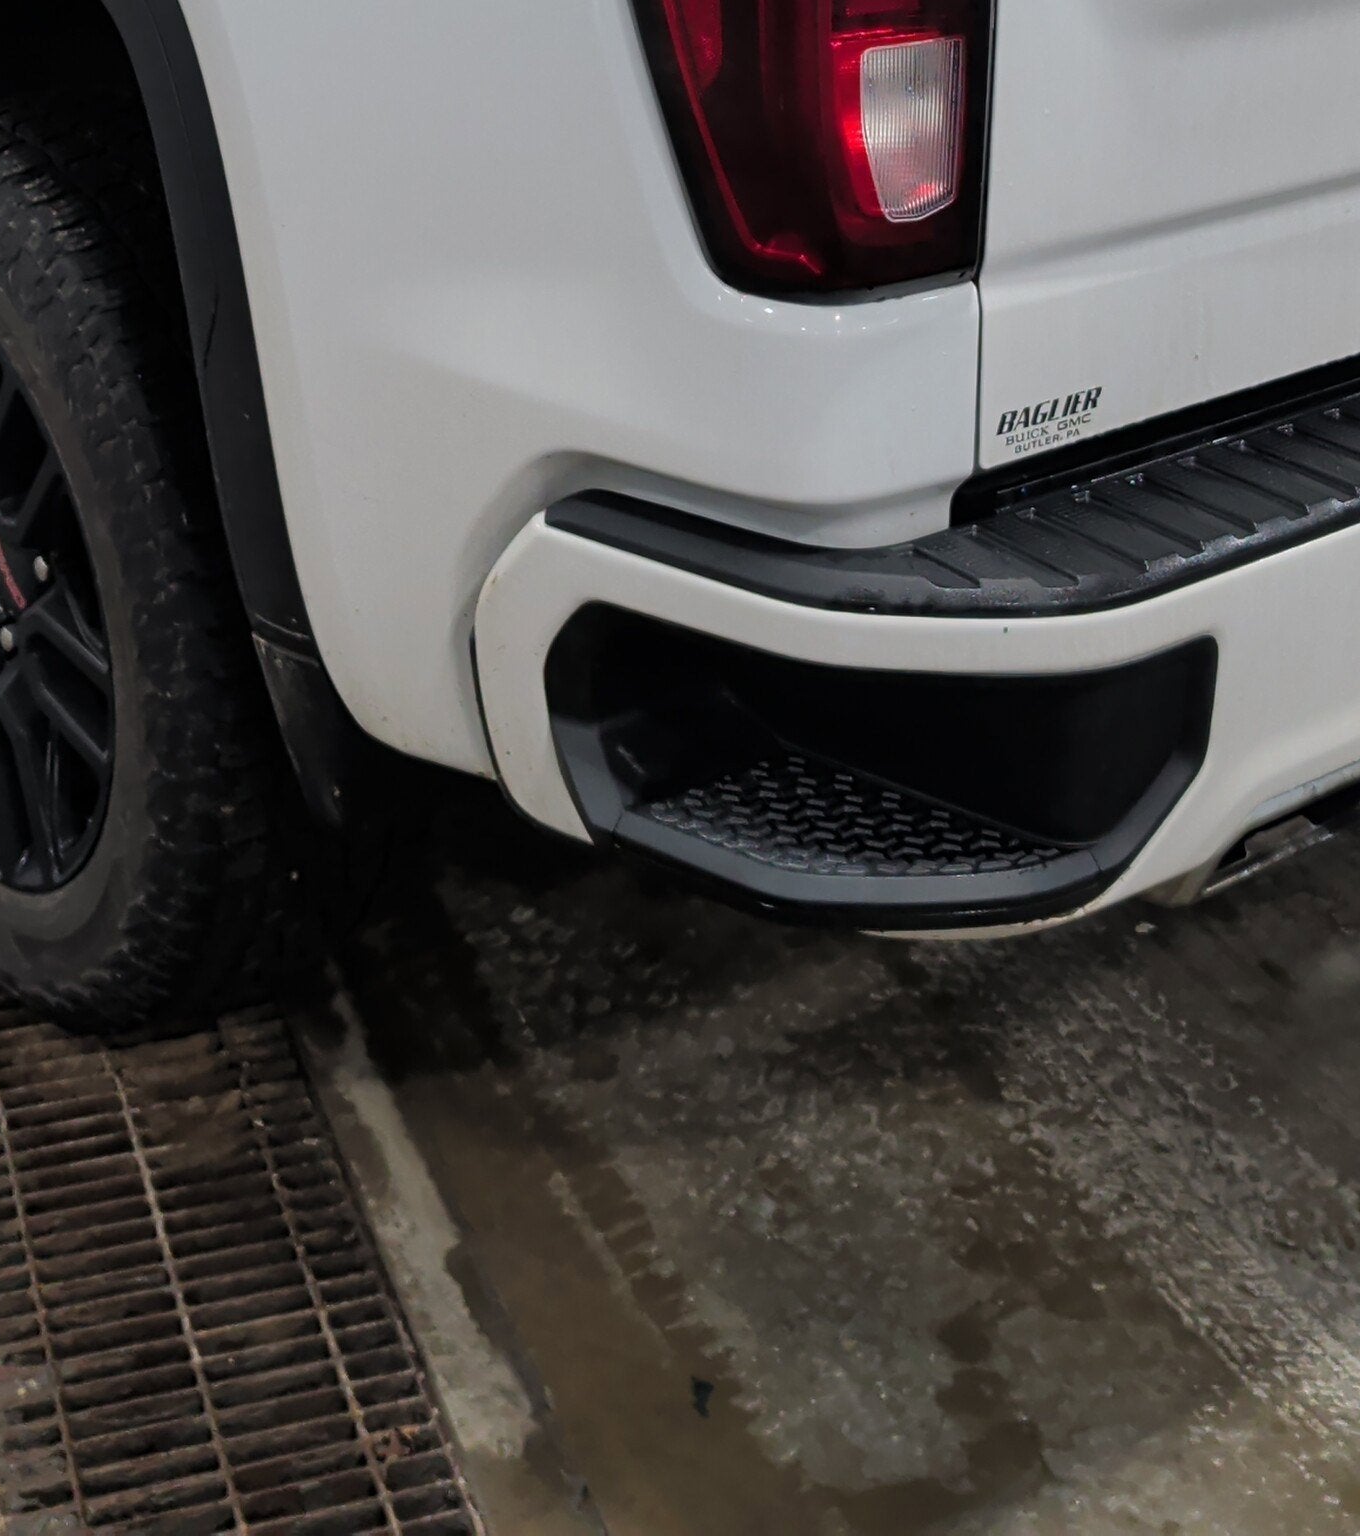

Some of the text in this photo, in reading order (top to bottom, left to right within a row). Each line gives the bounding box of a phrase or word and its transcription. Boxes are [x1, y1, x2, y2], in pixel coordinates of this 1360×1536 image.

[996, 386, 1102, 436] BAGLIER
[1006, 413, 1091, 446] BUICK GMC
[1066, 428, 1080, 439] PA
